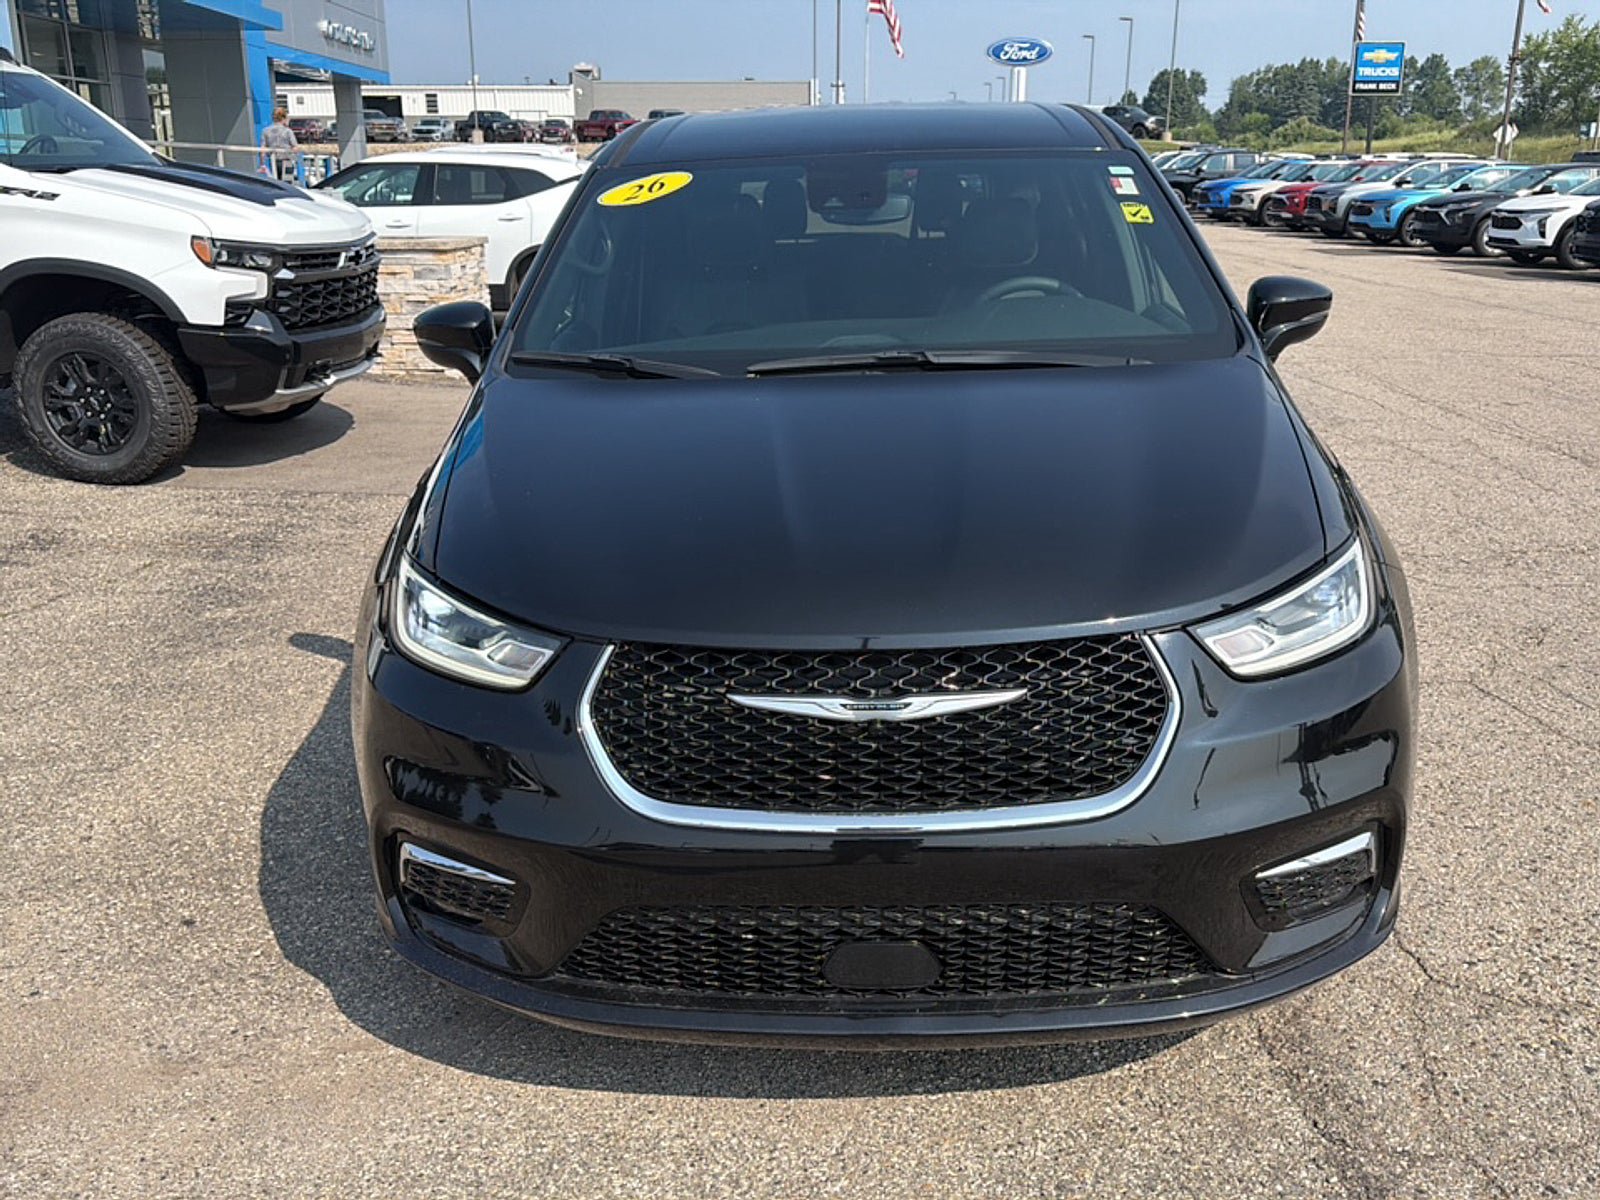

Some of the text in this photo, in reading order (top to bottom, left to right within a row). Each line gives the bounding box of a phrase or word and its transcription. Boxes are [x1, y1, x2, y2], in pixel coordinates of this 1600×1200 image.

[1000, 43, 1040, 60] Ford
[1358, 66, 1400, 77] TRUCKS
[622, 175, 665, 202] 26
